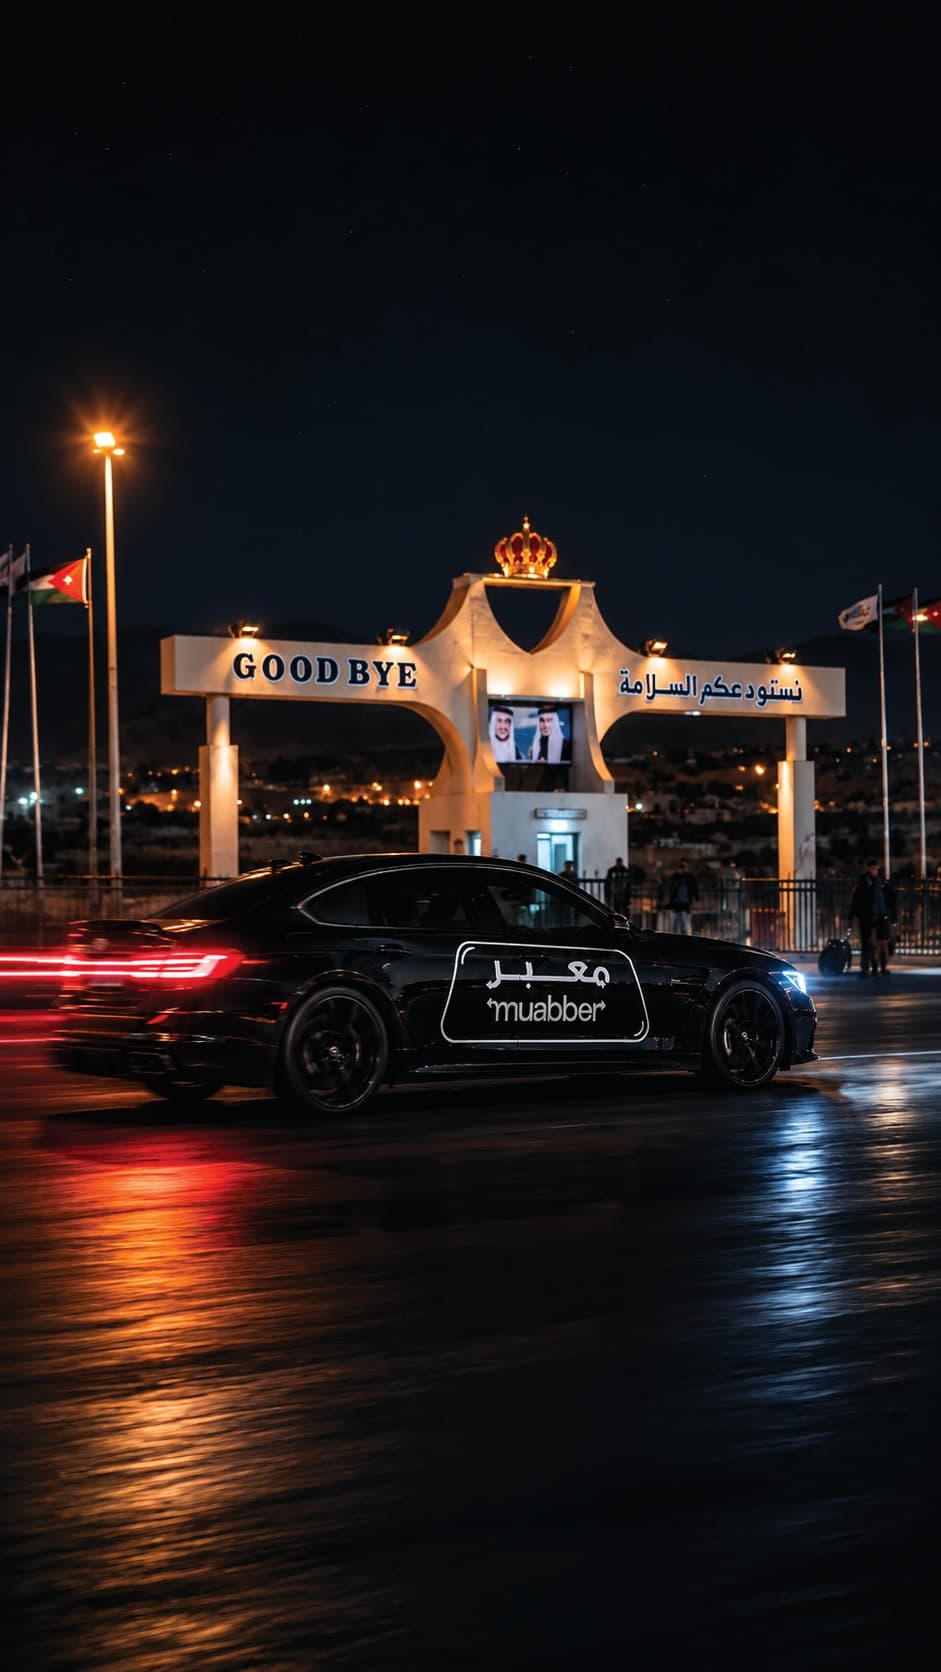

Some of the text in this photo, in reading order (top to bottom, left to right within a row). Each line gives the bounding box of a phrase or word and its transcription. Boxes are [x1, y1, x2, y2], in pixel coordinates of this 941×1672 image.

[232, 652, 418, 689] GOOD BYE
[619, 668, 803, 707] نستودعكم السلامة
[486, 960, 610, 989] معبر
[486, 994, 607, 1022] muabber
